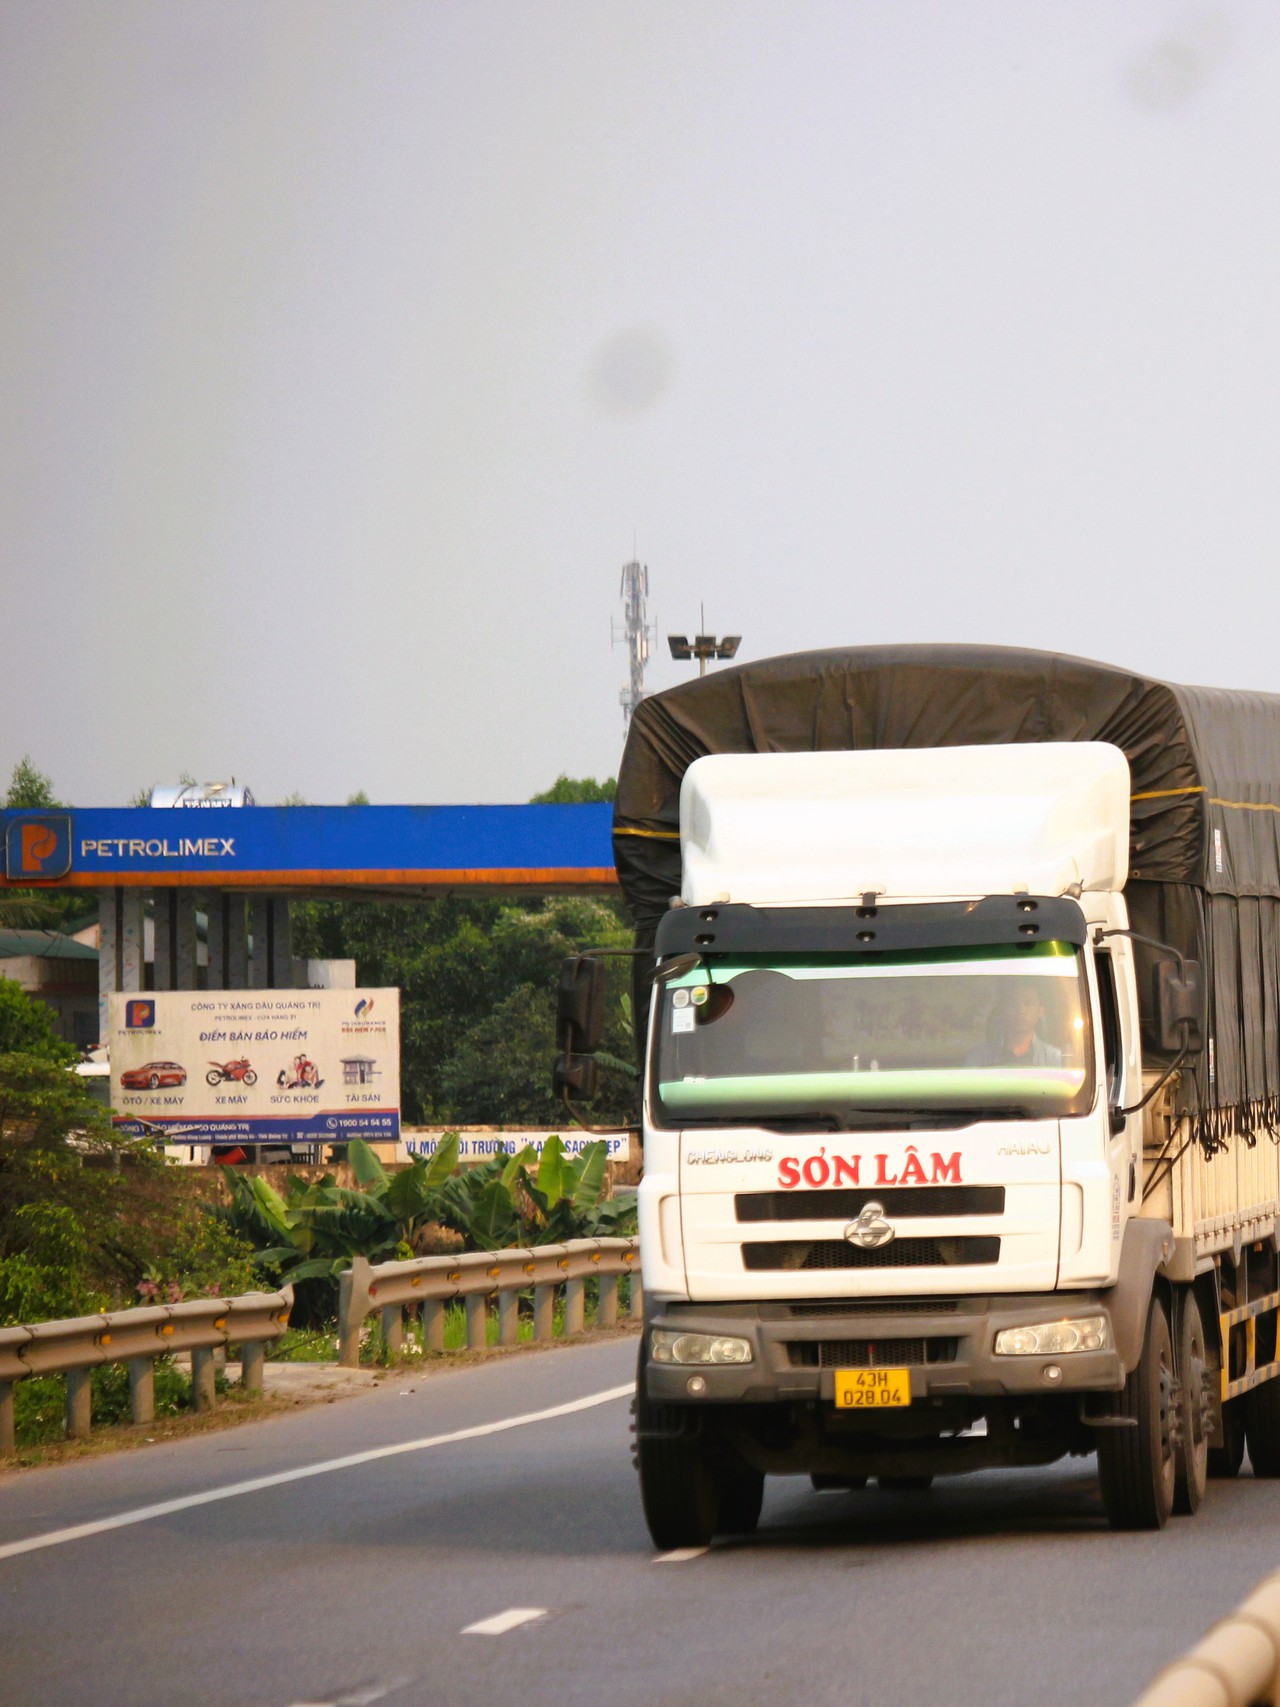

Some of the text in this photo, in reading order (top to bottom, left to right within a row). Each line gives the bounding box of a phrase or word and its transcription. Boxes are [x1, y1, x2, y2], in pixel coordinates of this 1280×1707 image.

[81, 838, 236, 857] PETROLIMEX
[215, 1096, 227, 1104] XE
[406, 1138, 416, 1154] VÌ
[687, 1149, 772, 1165] CHENGLONG
[874, 1145, 962, 1186] LÂM
[857, 1372, 888, 1387] 43H
[843, 1389, 901, 1405] 028.04
